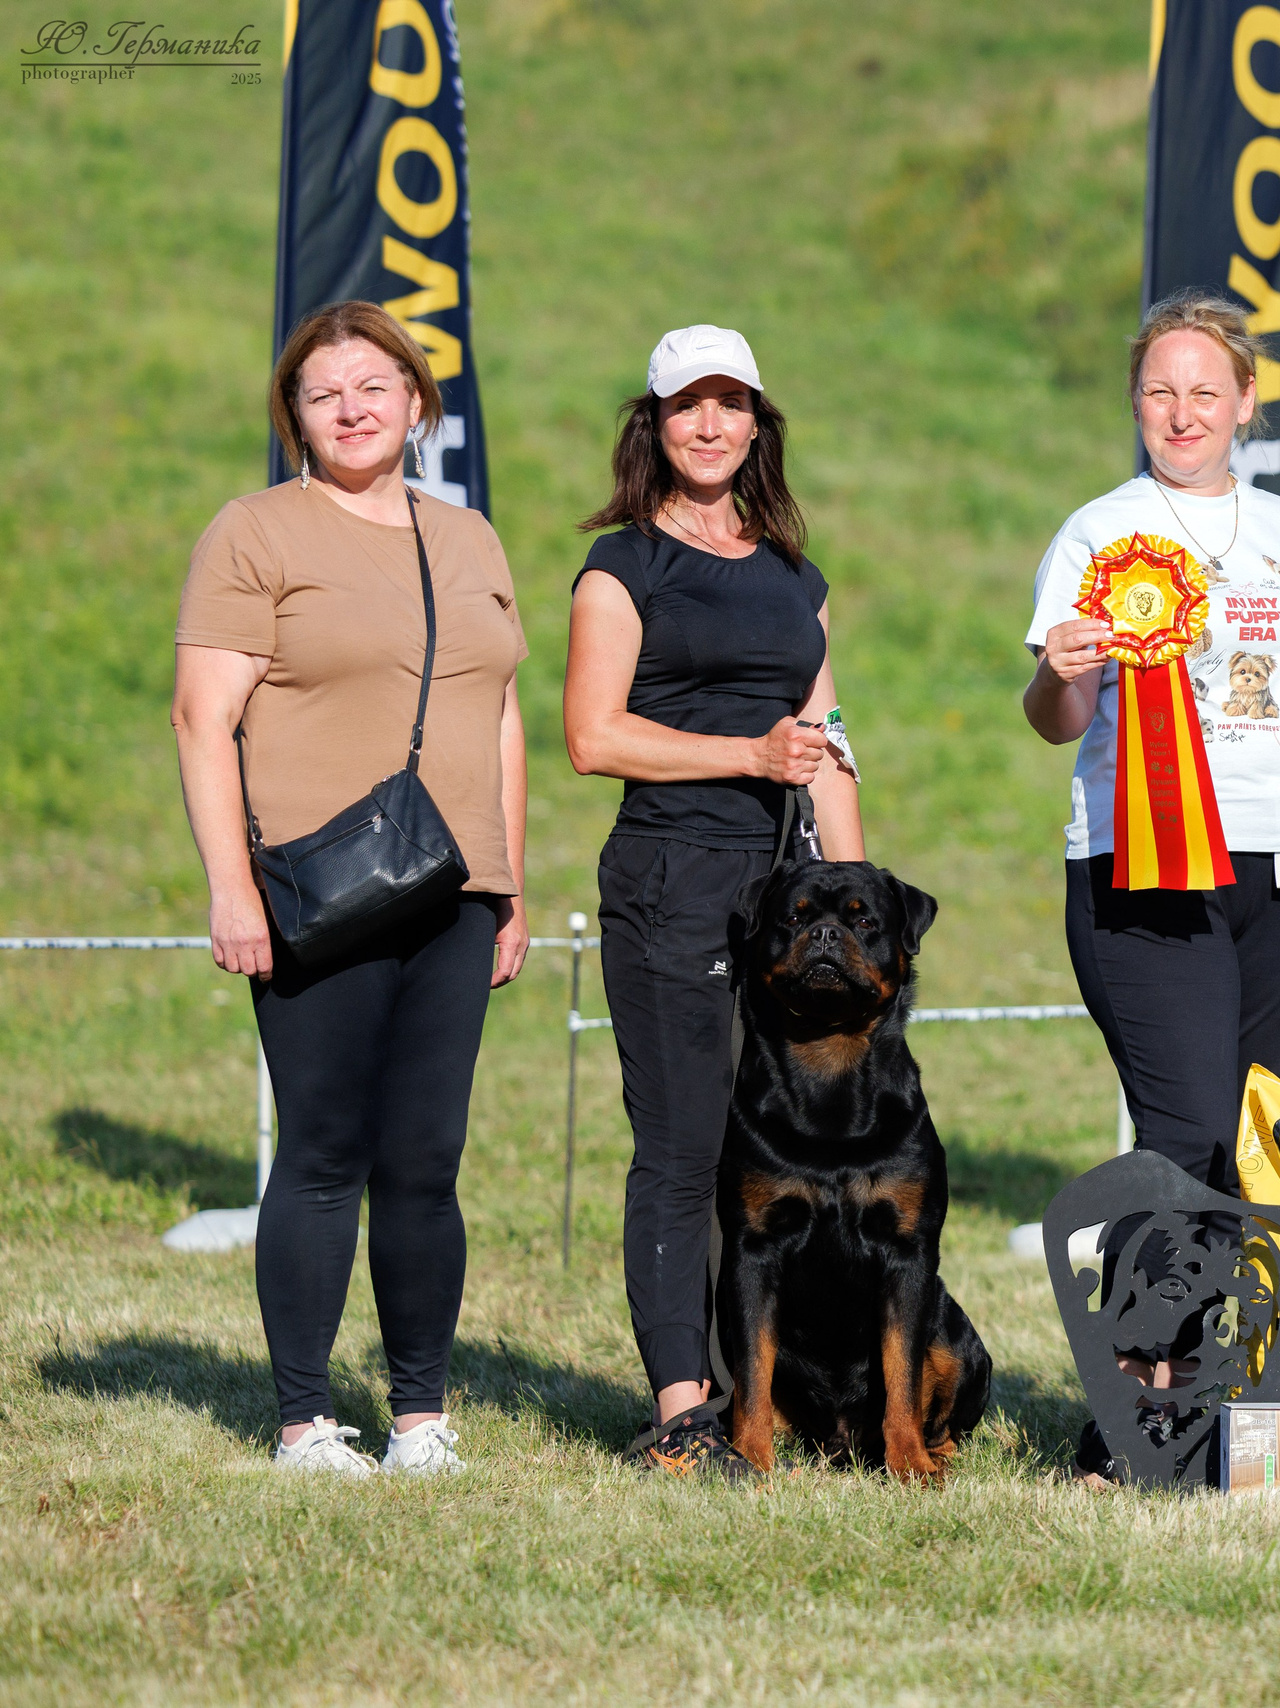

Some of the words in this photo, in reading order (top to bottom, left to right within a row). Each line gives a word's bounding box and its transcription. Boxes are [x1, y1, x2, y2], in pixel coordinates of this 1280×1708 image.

[1225, 597, 1247, 608] IN
[1249, 597, 1277, 608] MY
[1239, 626, 1277, 641] ERA
[1234, 722, 1256, 730] PRINTS
